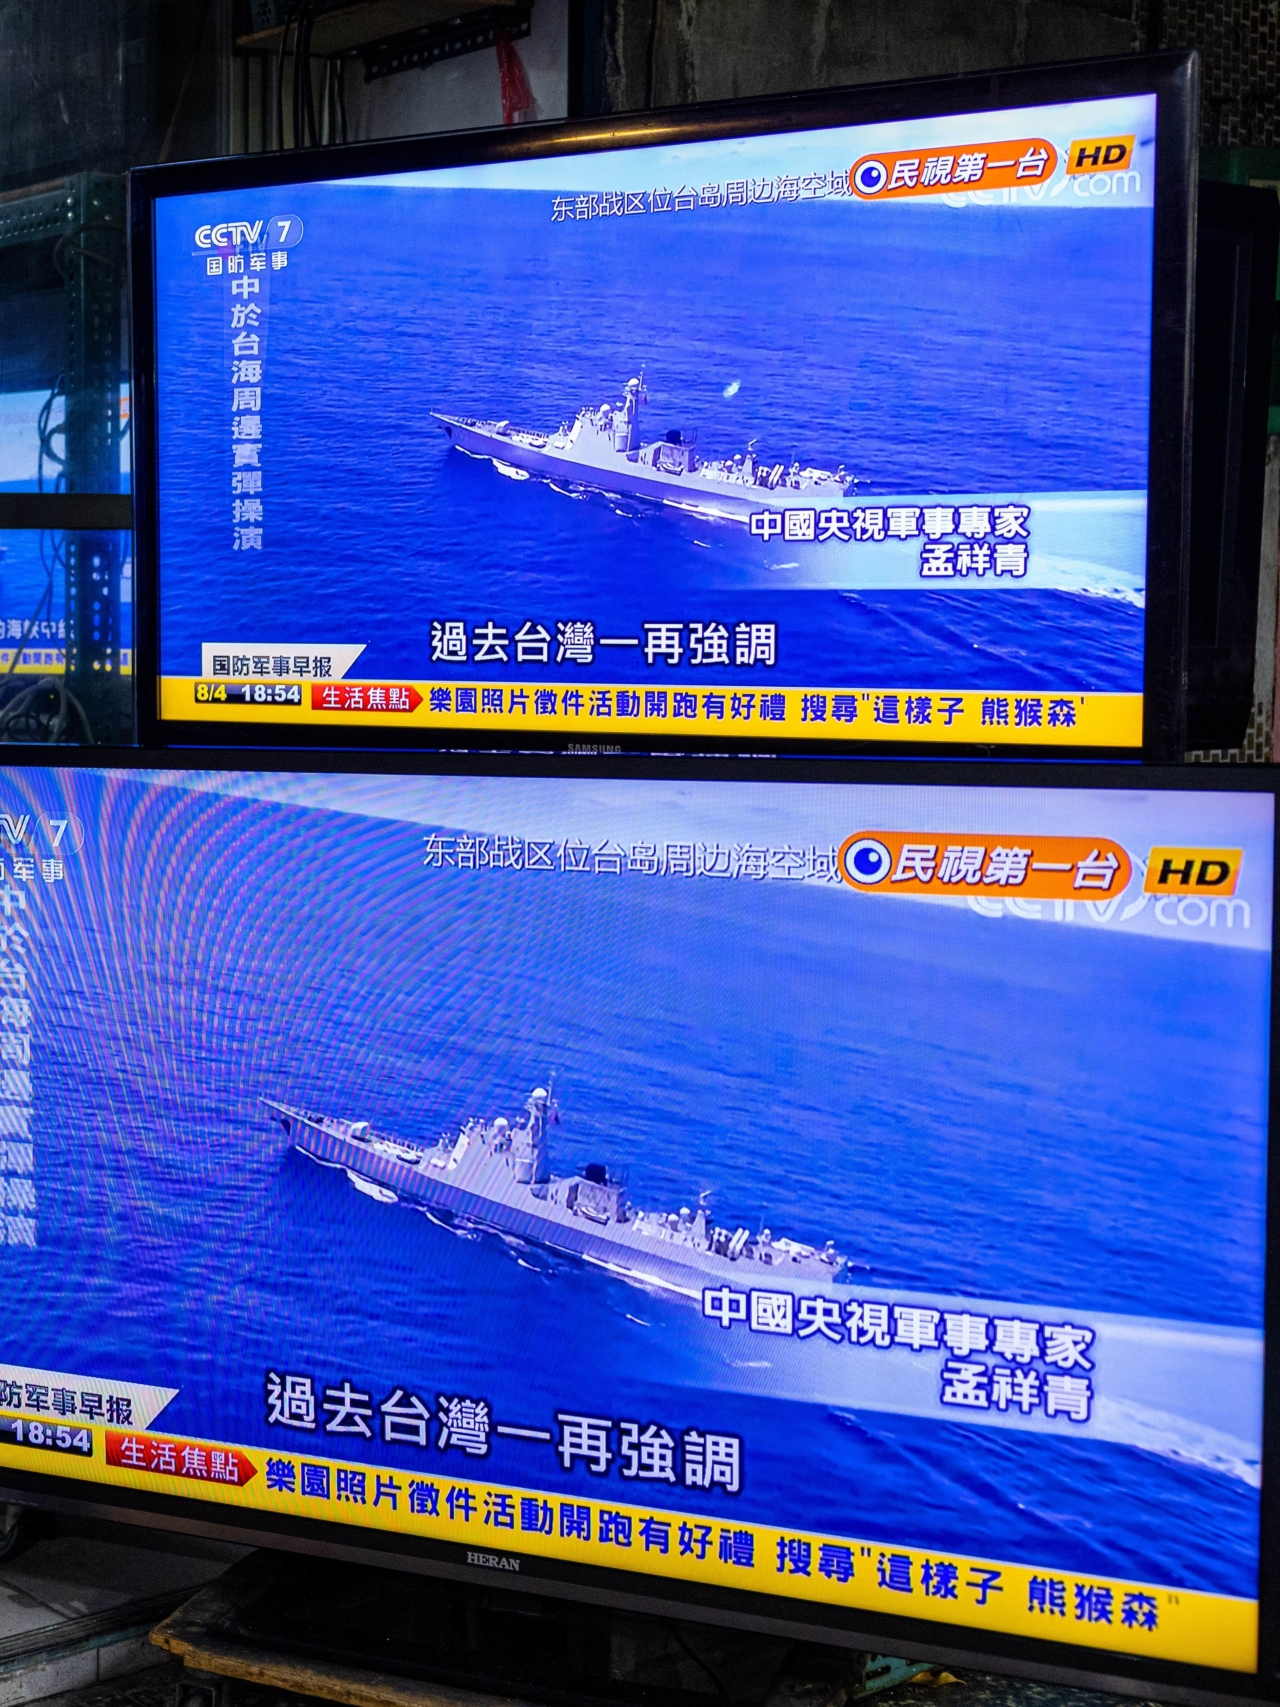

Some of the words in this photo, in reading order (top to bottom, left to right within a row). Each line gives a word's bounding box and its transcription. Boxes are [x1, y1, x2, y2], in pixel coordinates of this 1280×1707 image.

[886, 146, 1050, 191] 民視第一台
[1075, 144, 1128, 168] HD
[550, 169, 854, 223] 东部战区位台岛周边海空域
[194, 219, 264, 249] CCTV
[277, 220, 292, 243] 7
[206, 250, 289, 276] 国防军事
[750, 504, 1031, 543] 中國央視軍事專家
[919, 543, 1029, 578] 孟祥青
[431, 619, 777, 667] 過去台灣一再強調
[213, 655, 333, 678] 国防军事早报
[196, 684, 227, 702] 8/4
[241, 684, 300, 703] 18:54
[322, 685, 411, 711] 生活焦點
[429, 687, 787, 722] 樂園照片徵件活動開跑有好禮
[567, 743, 622, 754] SAMSUNG
[48, 819, 69, 848] 7
[422, 832, 842, 883] 东部战区位台岛周边海空域
[891, 844, 1120, 891] 民視第一台
[1157, 859, 1231, 887] HD
[703, 1286, 1095, 1372] 中國央視軍事專家
[941, 1360, 1093, 1423] 孟祥青
[10, 1418, 91, 1453] 18:54
[267, 1371, 741, 1494] 過去台灣一再強調
[120, 1437, 239, 1484] 生活焦點
[265, 1457, 756, 1570] 樂園照片徵件活動開跑有好禮
[466, 1551, 520, 1572] HERAN
